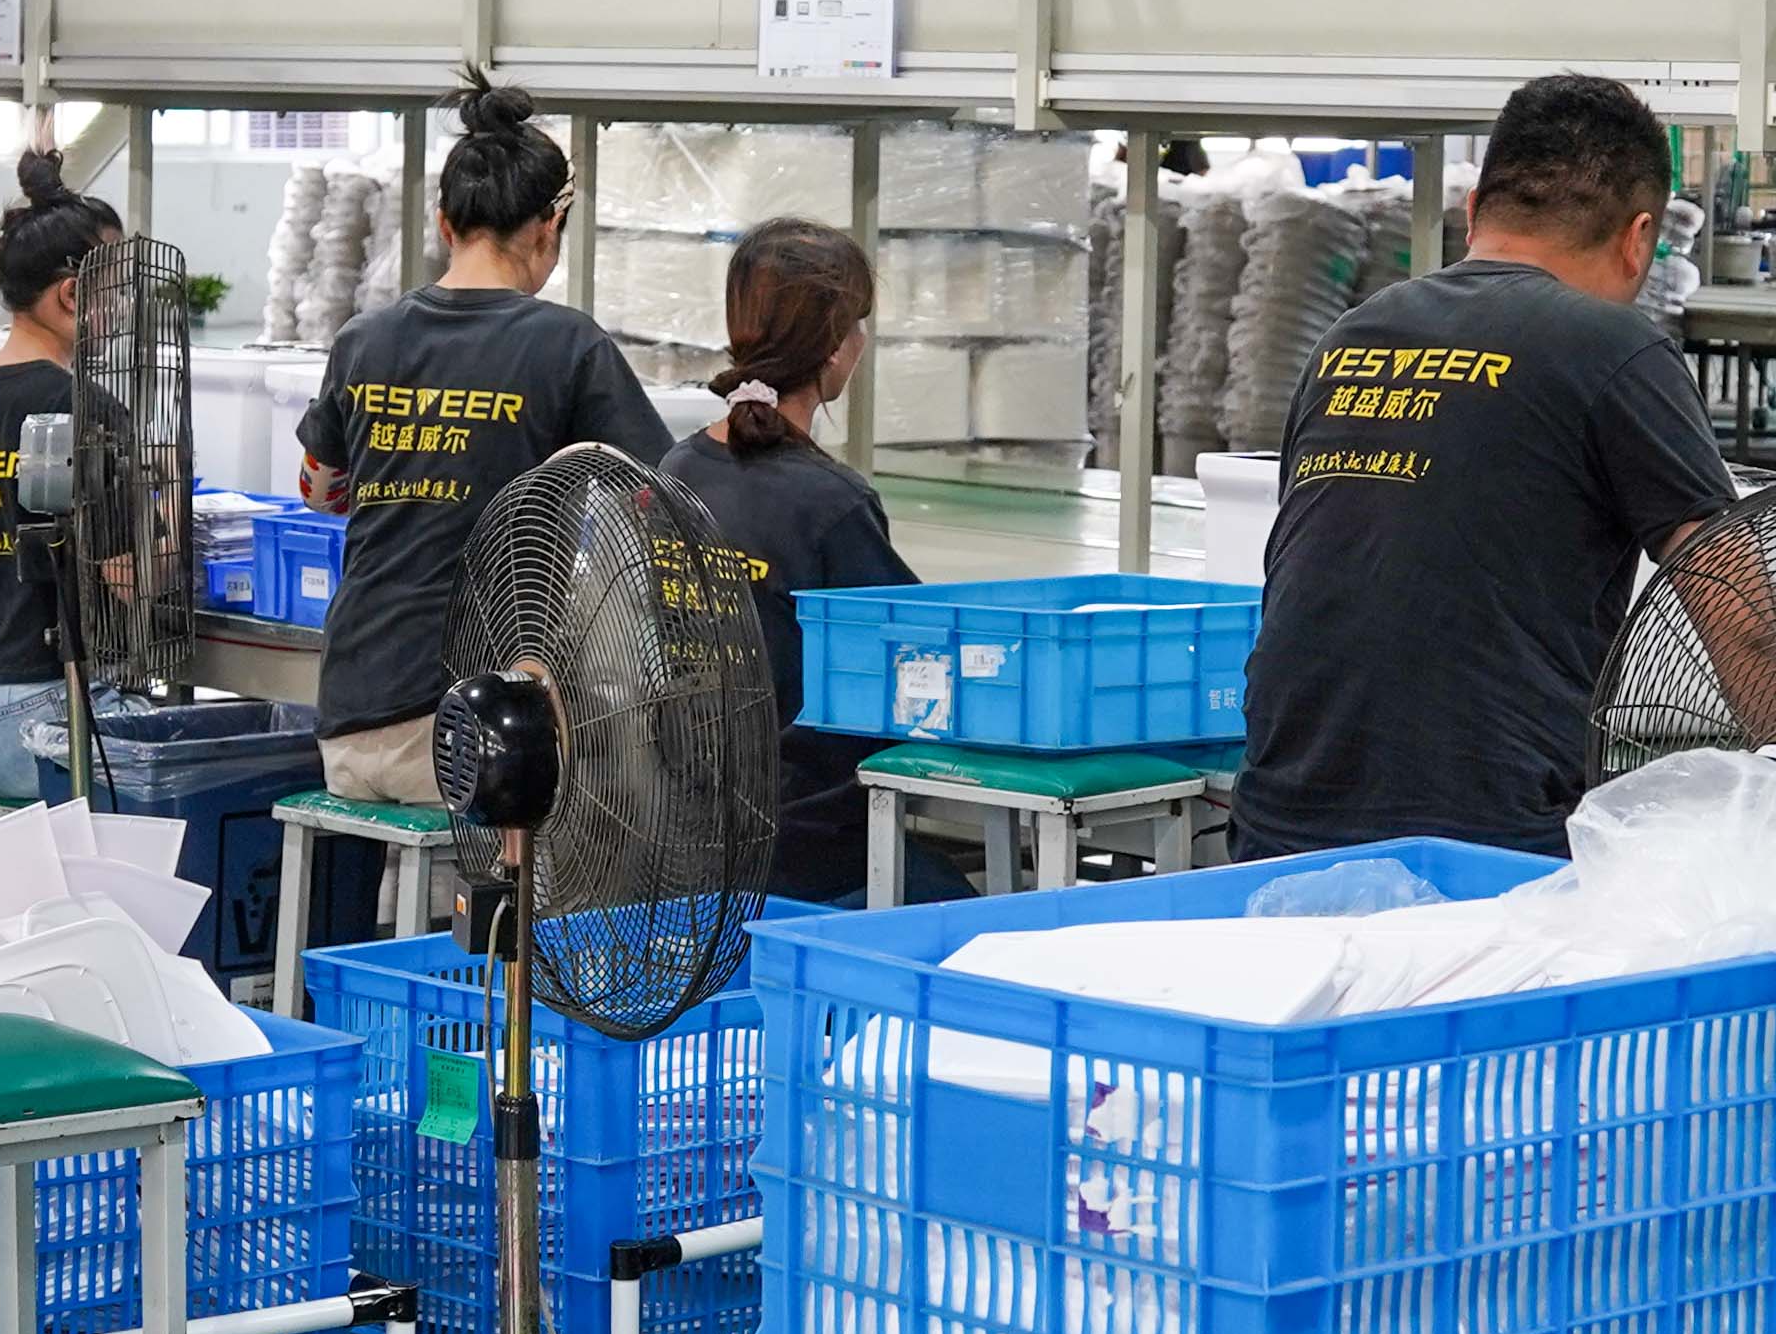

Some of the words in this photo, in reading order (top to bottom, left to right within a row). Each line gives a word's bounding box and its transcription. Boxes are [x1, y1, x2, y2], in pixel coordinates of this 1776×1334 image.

[1316, 347, 1512, 388] YESVEER
[346, 383, 524, 424] YESVEER
[1325, 385, 1441, 421] 越盛威尔
[369, 421, 471, 454] 越盛威尔
